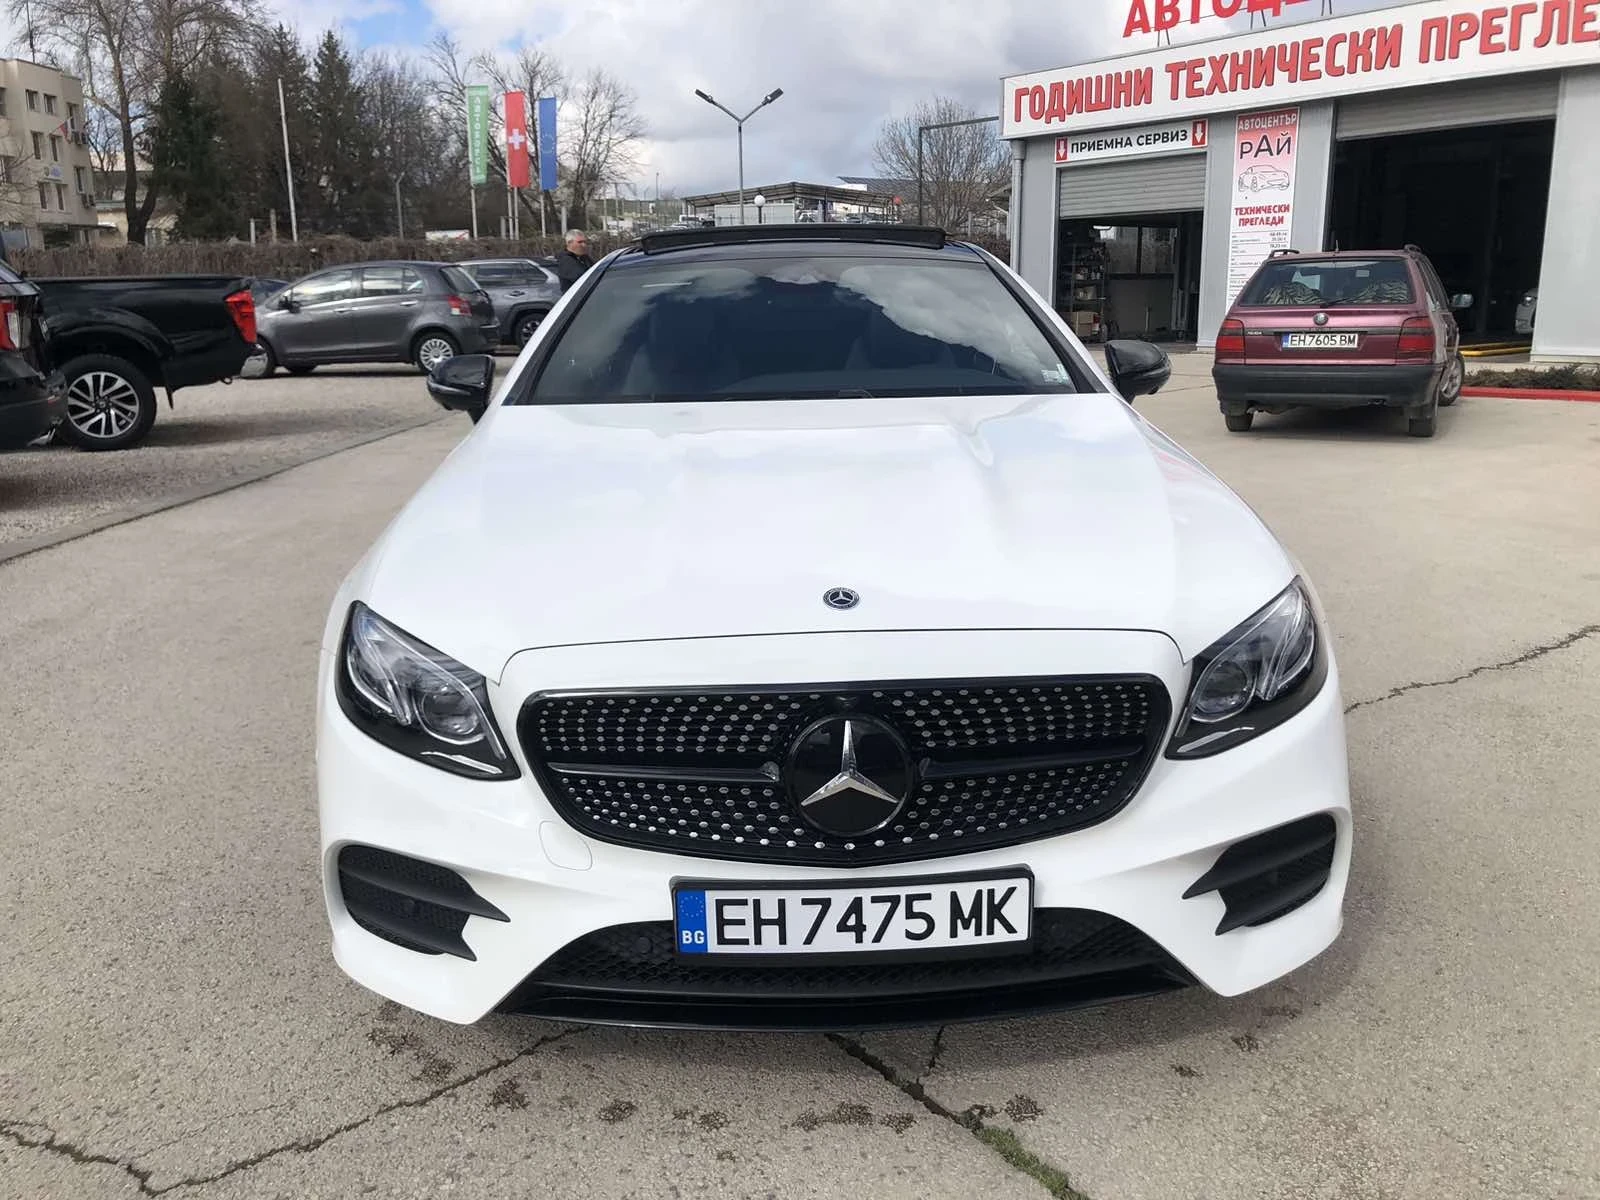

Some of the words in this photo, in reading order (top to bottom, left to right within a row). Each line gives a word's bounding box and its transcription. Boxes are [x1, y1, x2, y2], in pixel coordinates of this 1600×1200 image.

[1014, 67, 1153, 124] ГОДИШНИ
[1165, 23, 1403, 100] ТЕХНИЧЕСКИ
[1419, 0, 1600, 64] ПРЕГЛЕ
[1238, 113, 1297, 130] АВТОЦЕНТЪР
[1071, 137, 1133, 153] ПРИЕМНА
[1136, 129, 1188, 147] СЕРВИЗ
[1239, 131, 1292, 160] РАЙ
[1234, 203, 1290, 216] ТЕХНИЧЕСКИ
[1238, 215, 1285, 227] ПРЕГЛЕДИ
[1308, 335, 1337, 346] 7605
[1339, 334, 1357, 346] BM
[715, 898, 787, 946] EH
[801, 892, 936, 945] 7475
[949, 886, 1018, 939] MK
[682, 930, 705, 945] BG
